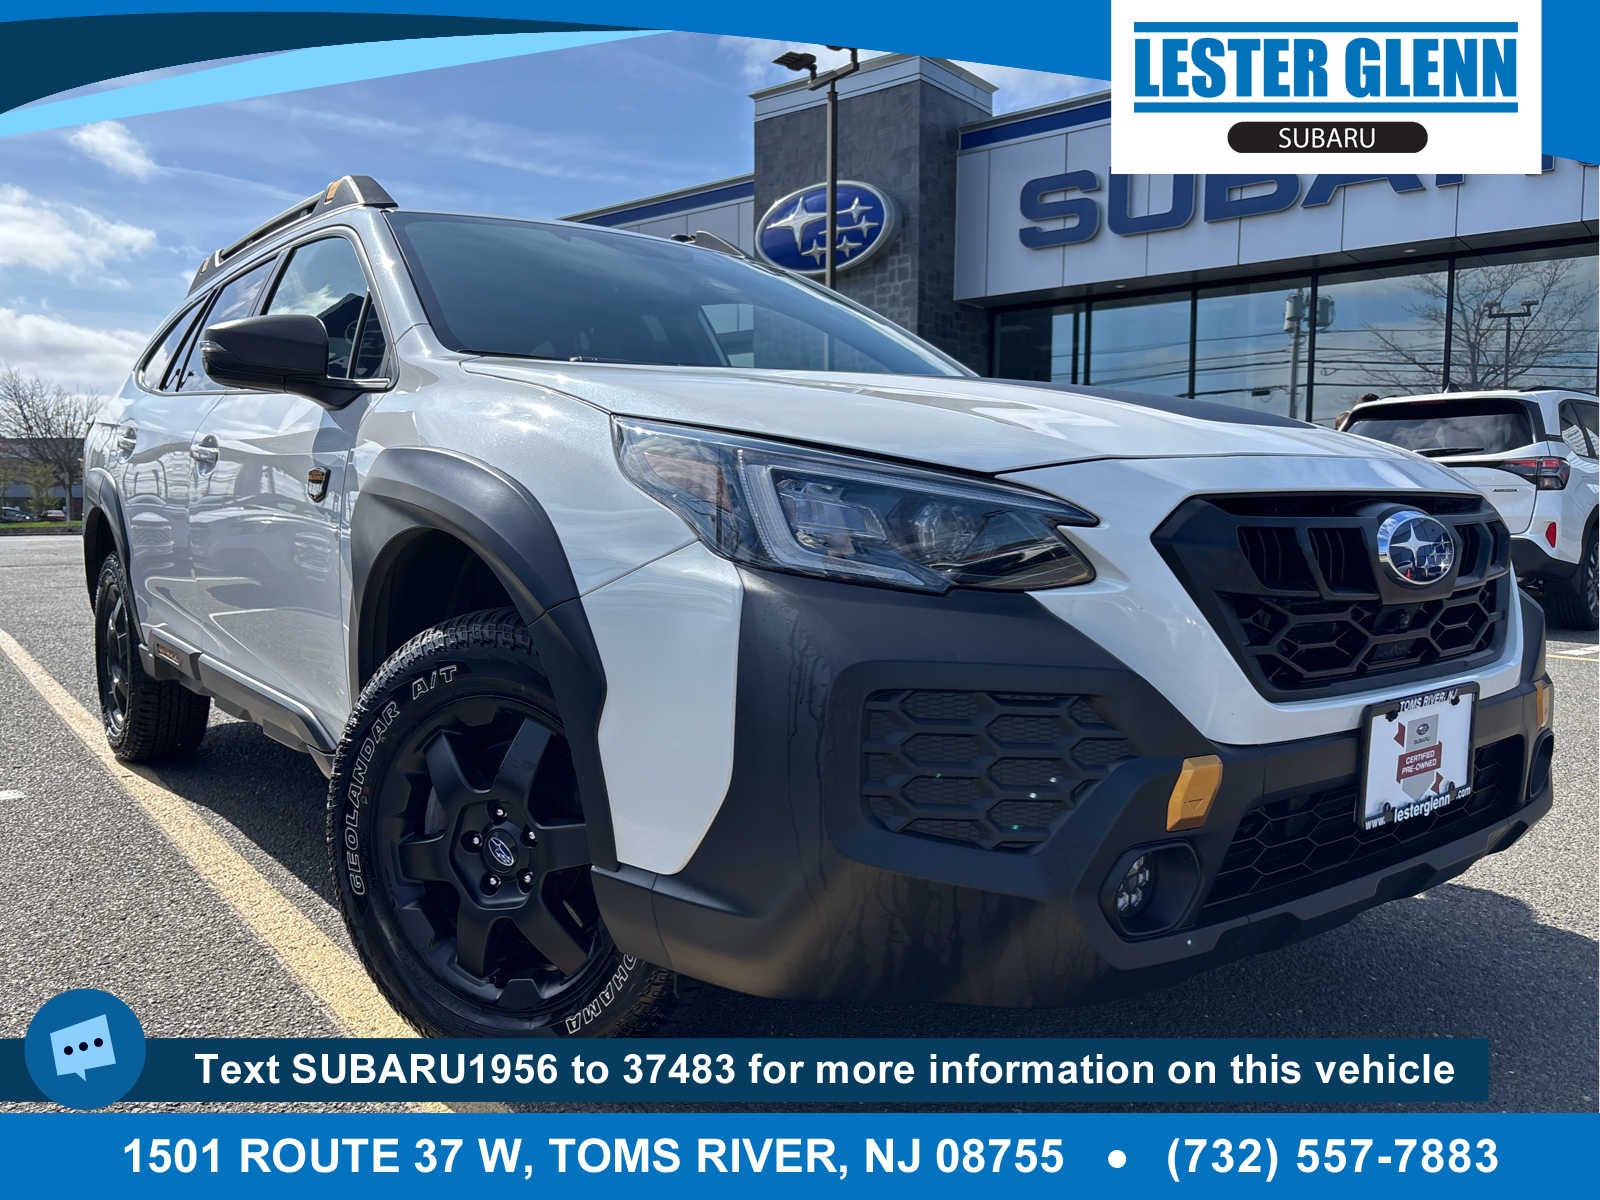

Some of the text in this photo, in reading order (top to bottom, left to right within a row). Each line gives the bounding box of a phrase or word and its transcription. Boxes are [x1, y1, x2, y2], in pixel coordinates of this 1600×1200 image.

[1400, 697, 1422, 711] TOMS
[1405, 750, 1435, 765] CERTIFIED
[1401, 758, 1437, 775] PRE-OWNED
[344, 665, 457, 896] GEOLANDAR A/T
[1394, 794, 1450, 823] lesterglenn
